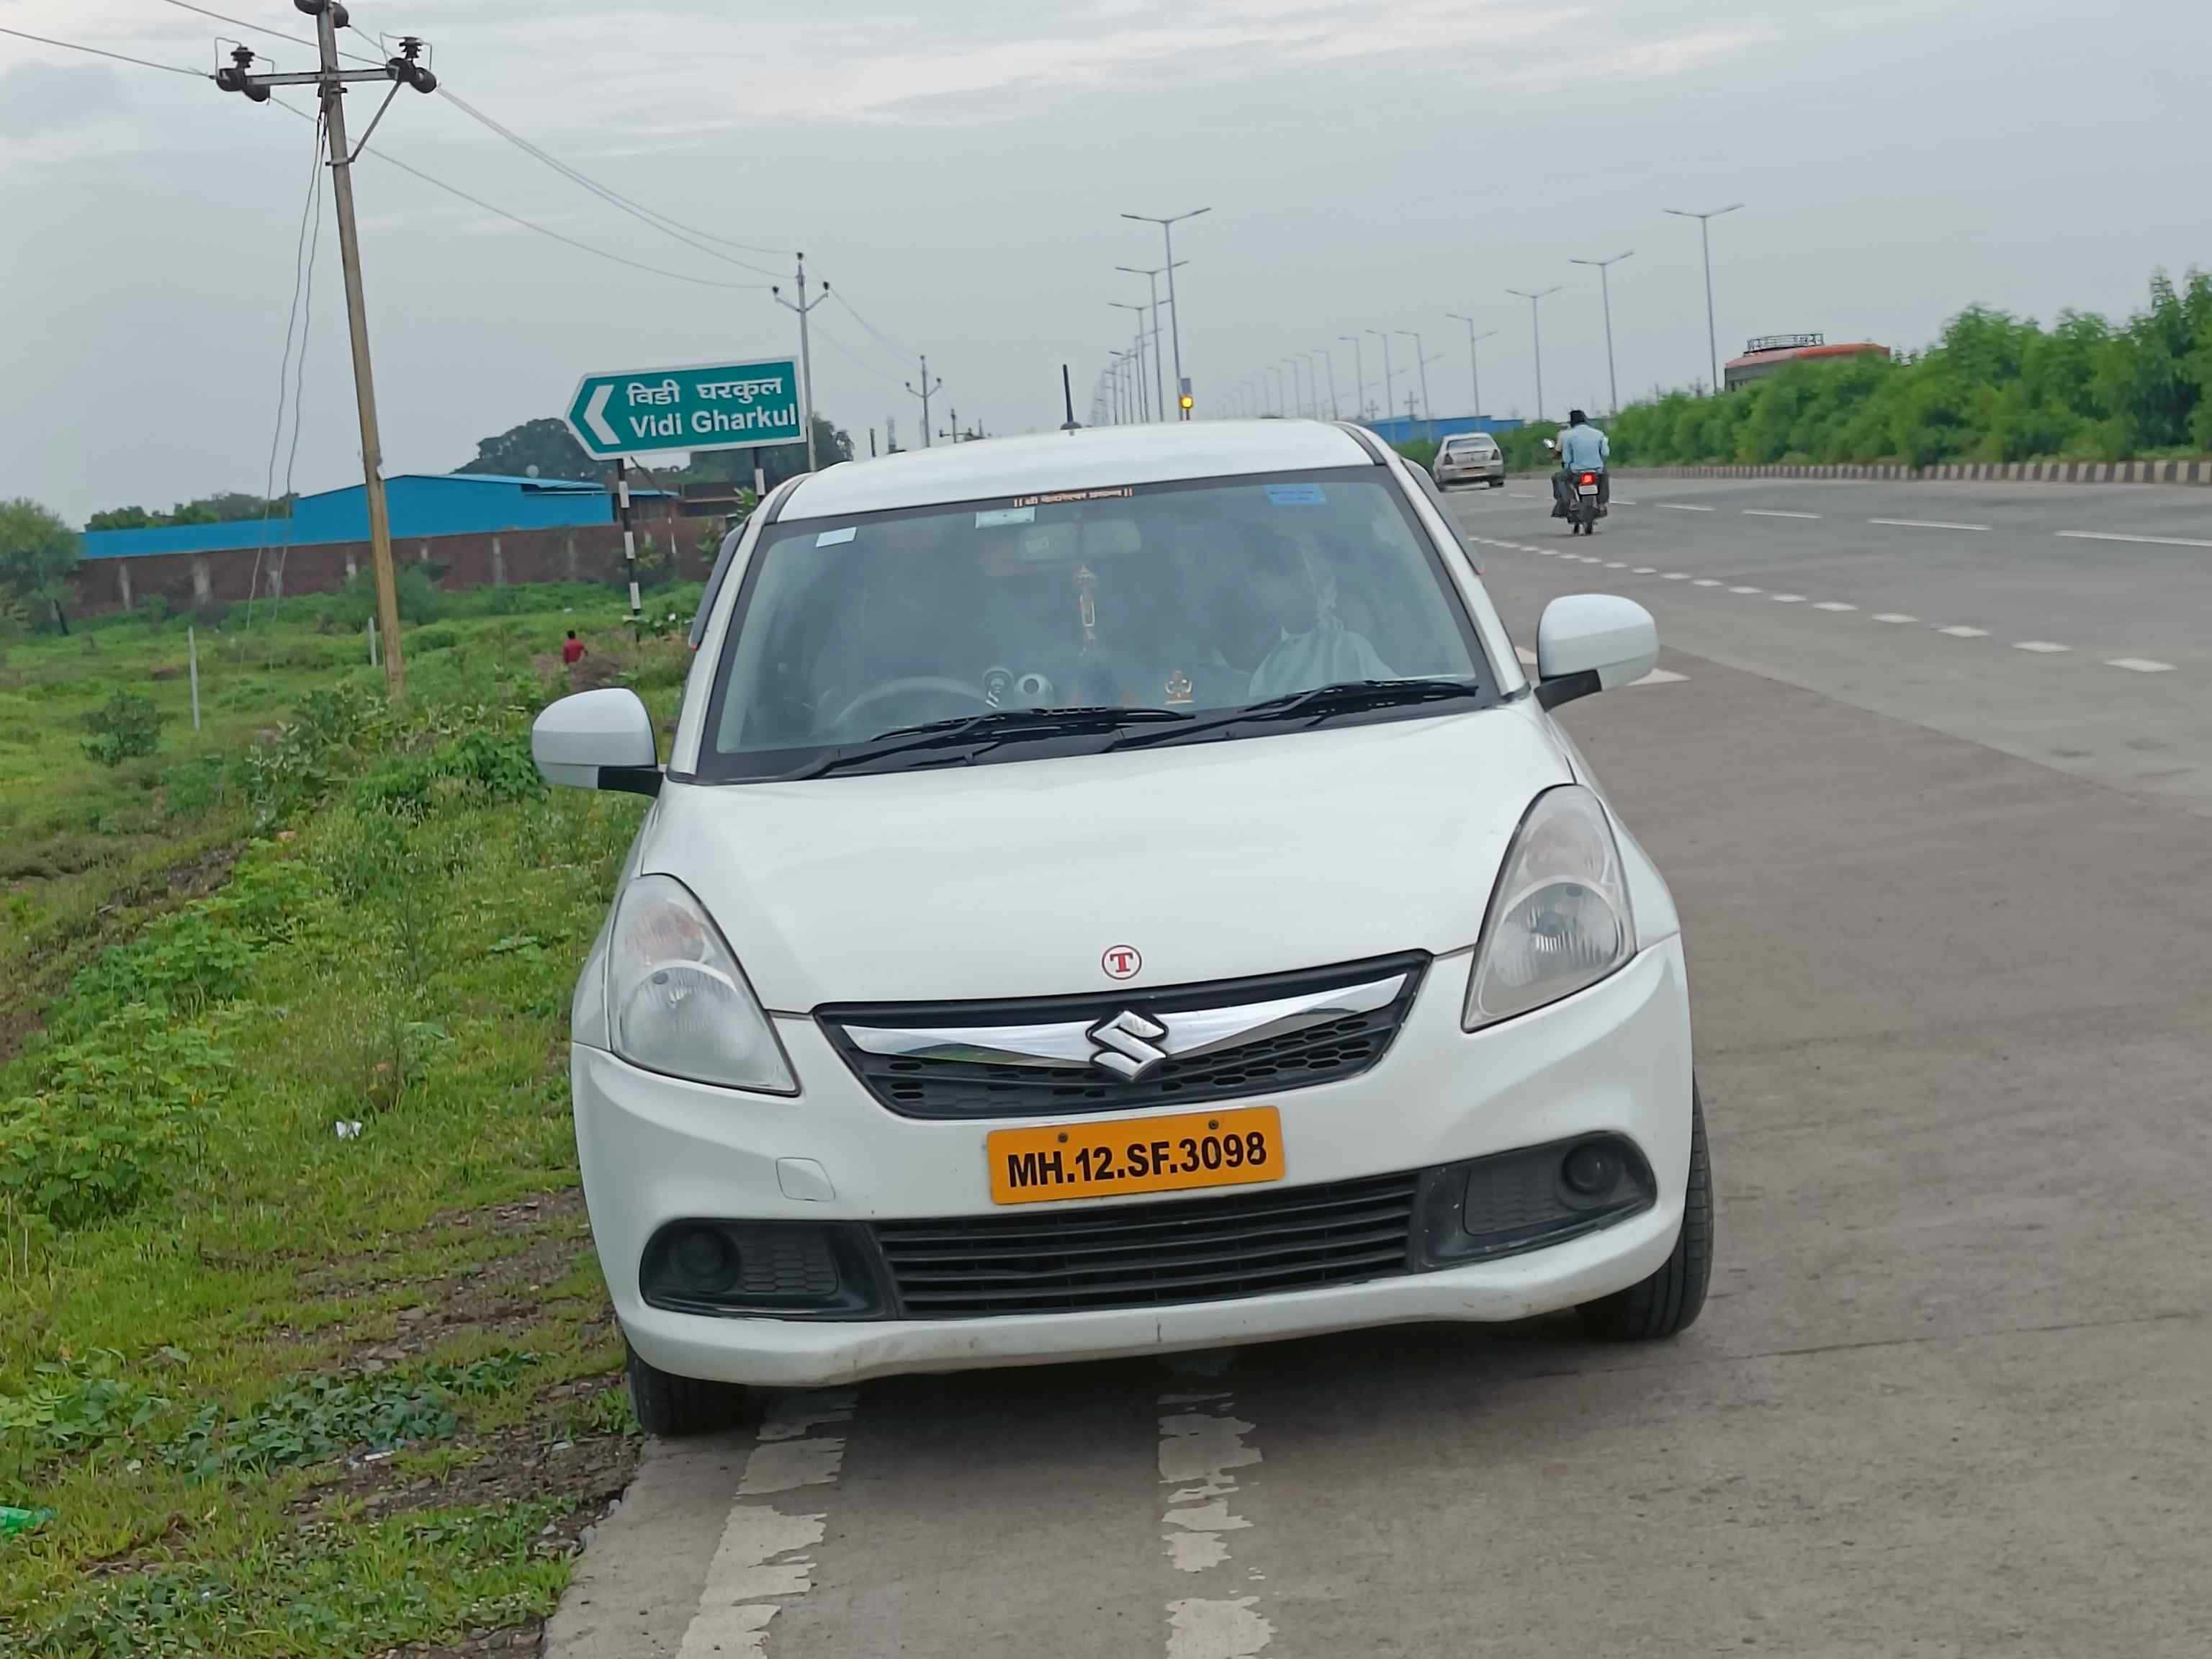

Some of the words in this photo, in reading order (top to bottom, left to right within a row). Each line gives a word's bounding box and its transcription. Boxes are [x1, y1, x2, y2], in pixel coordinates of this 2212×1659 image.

[627, 379, 680, 407] विडी
[696, 377, 783, 404] घरकुल
[629, 412, 683, 439] Vidi
[691, 403, 796, 434] Gharkul
[1110, 951, 1133, 974] T
[1007, 1130, 1268, 1189] MH.12.SF.3098
